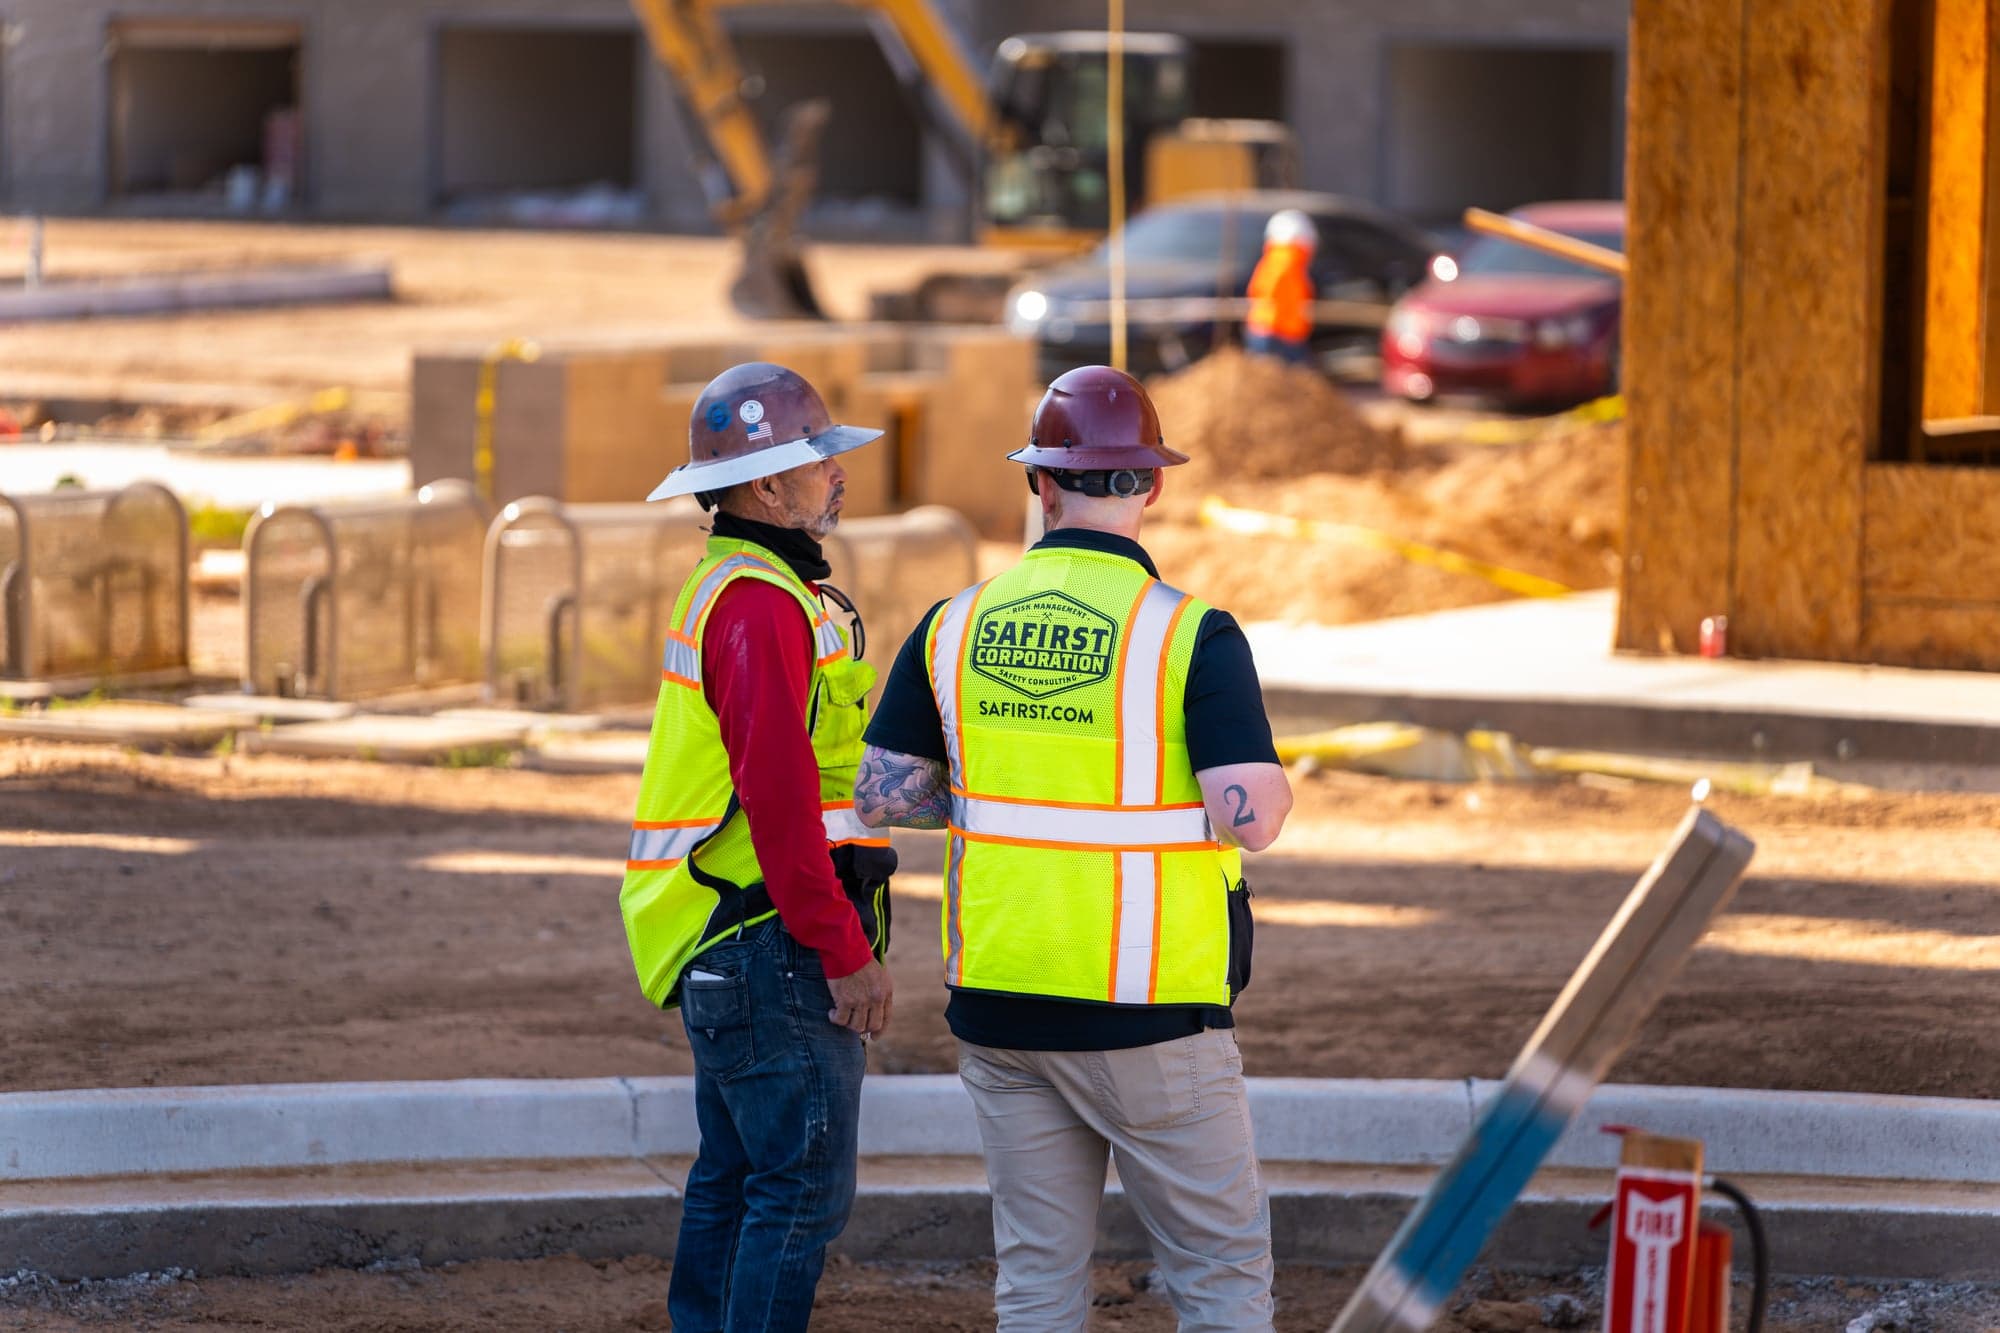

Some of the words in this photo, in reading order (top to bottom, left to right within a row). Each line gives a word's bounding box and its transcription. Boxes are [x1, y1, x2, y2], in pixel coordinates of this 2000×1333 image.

[1012, 603, 1031, 614] RISK
[1033, 603, 1087, 618] MANAGEMENT
[981, 621, 1109, 653] SAFIRST
[976, 647, 1105, 673] CORPORATION
[999, 669, 1027, 684] SAFETY
[1028, 673, 1077, 686] CONSULTING
[979, 700, 1094, 724] SAFIRST.COM
[1223, 784, 1256, 827] 2
[1635, 1209, 1675, 1238] FIRE
